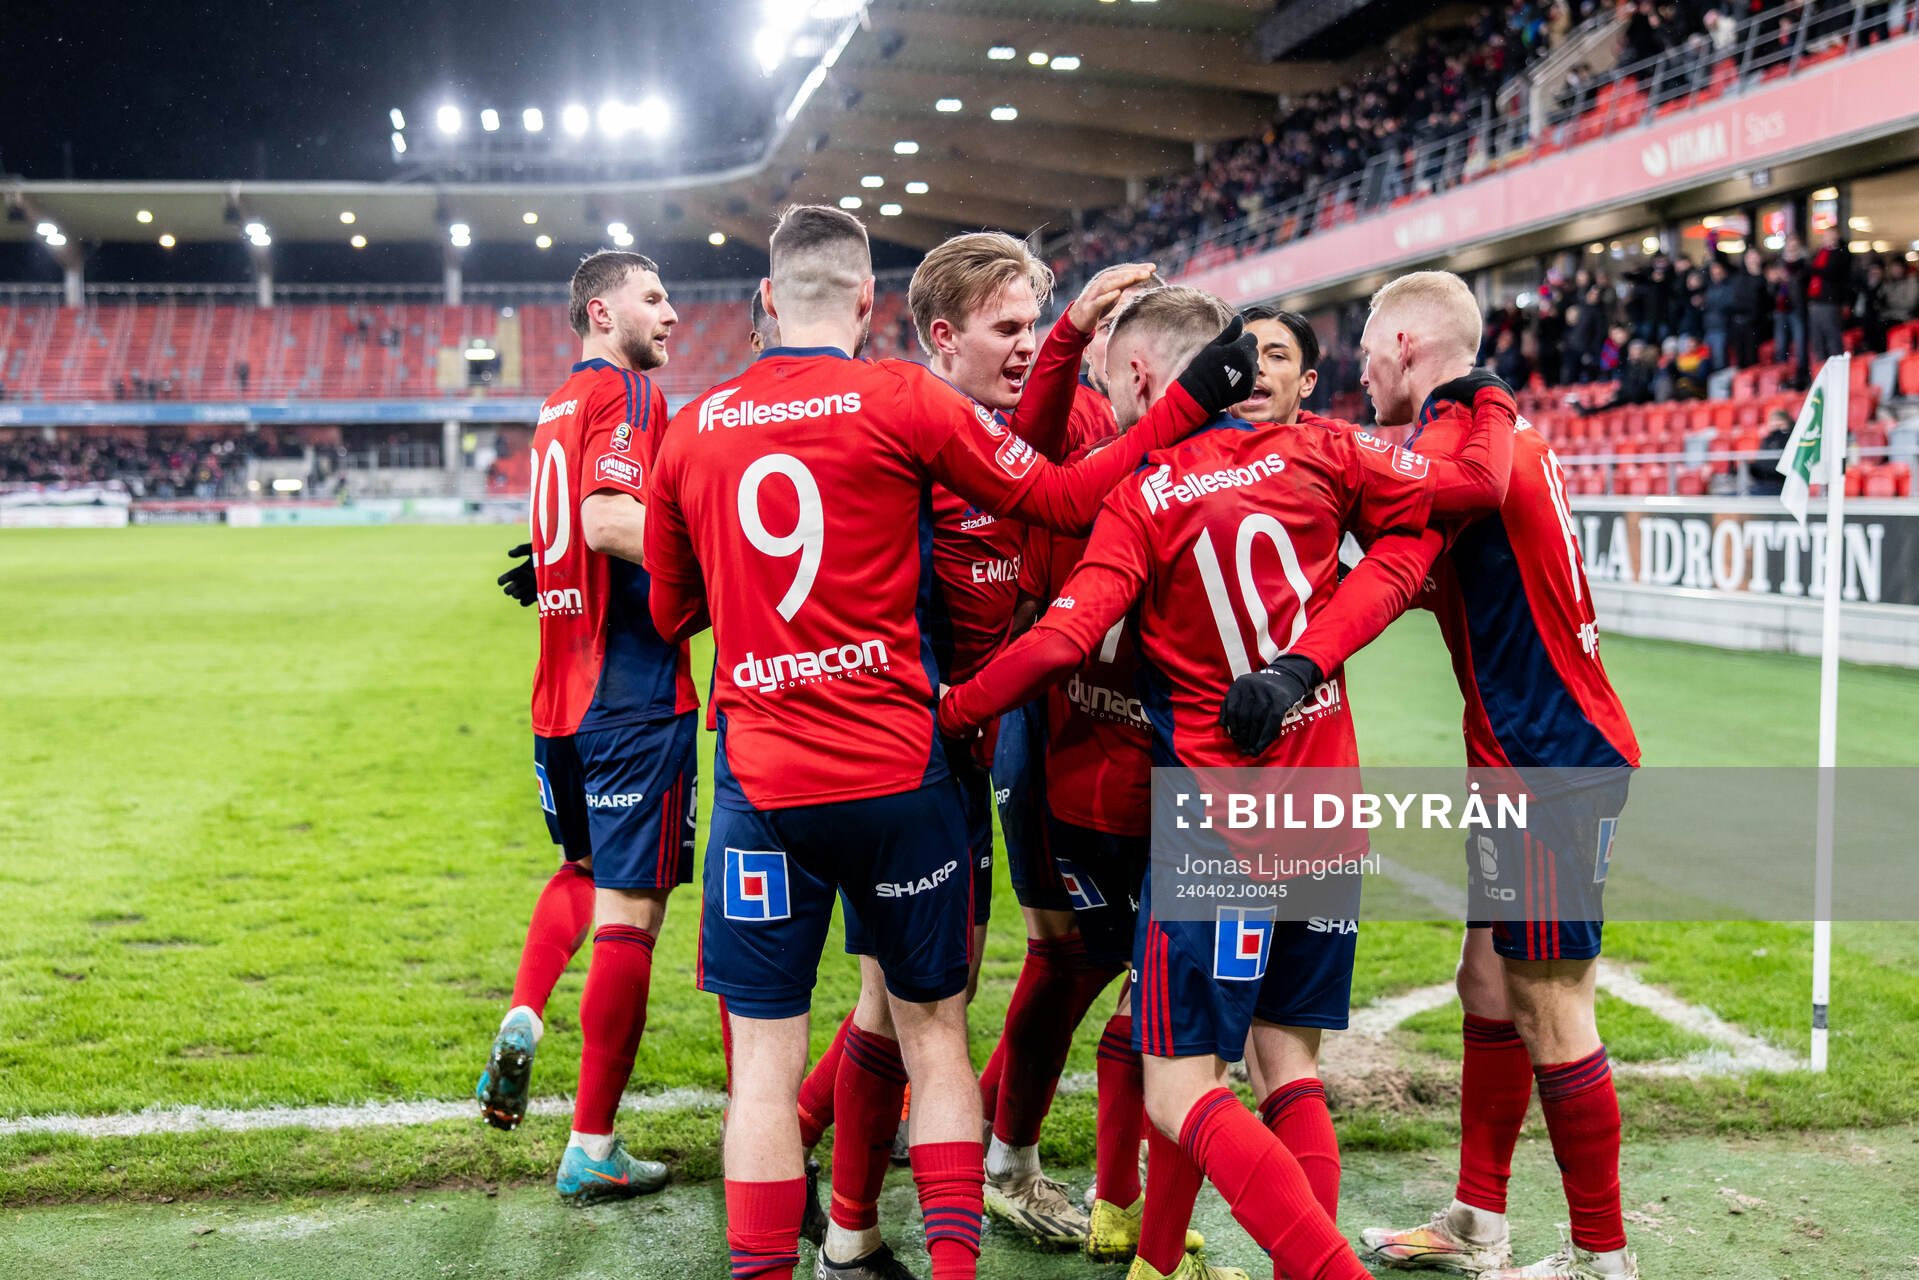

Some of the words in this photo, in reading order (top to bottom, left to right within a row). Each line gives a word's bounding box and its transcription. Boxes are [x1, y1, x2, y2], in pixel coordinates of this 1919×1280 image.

[701, 388, 861, 432] Fellessons
[600, 458, 639, 478] UNIBET
[1142, 453, 1286, 514] Fellessons
[737, 453, 824, 623] 9
[1573, 514, 1631, 580] LA
[1193, 513, 1313, 681] 10
[733, 639, 888, 693] dynacon
[779, 664, 890, 690] CONSTRUCTION
[1068, 673, 1152, 724] dynac
[875, 860, 958, 898] SHARP
[1307, 916, 1359, 935] SHA
